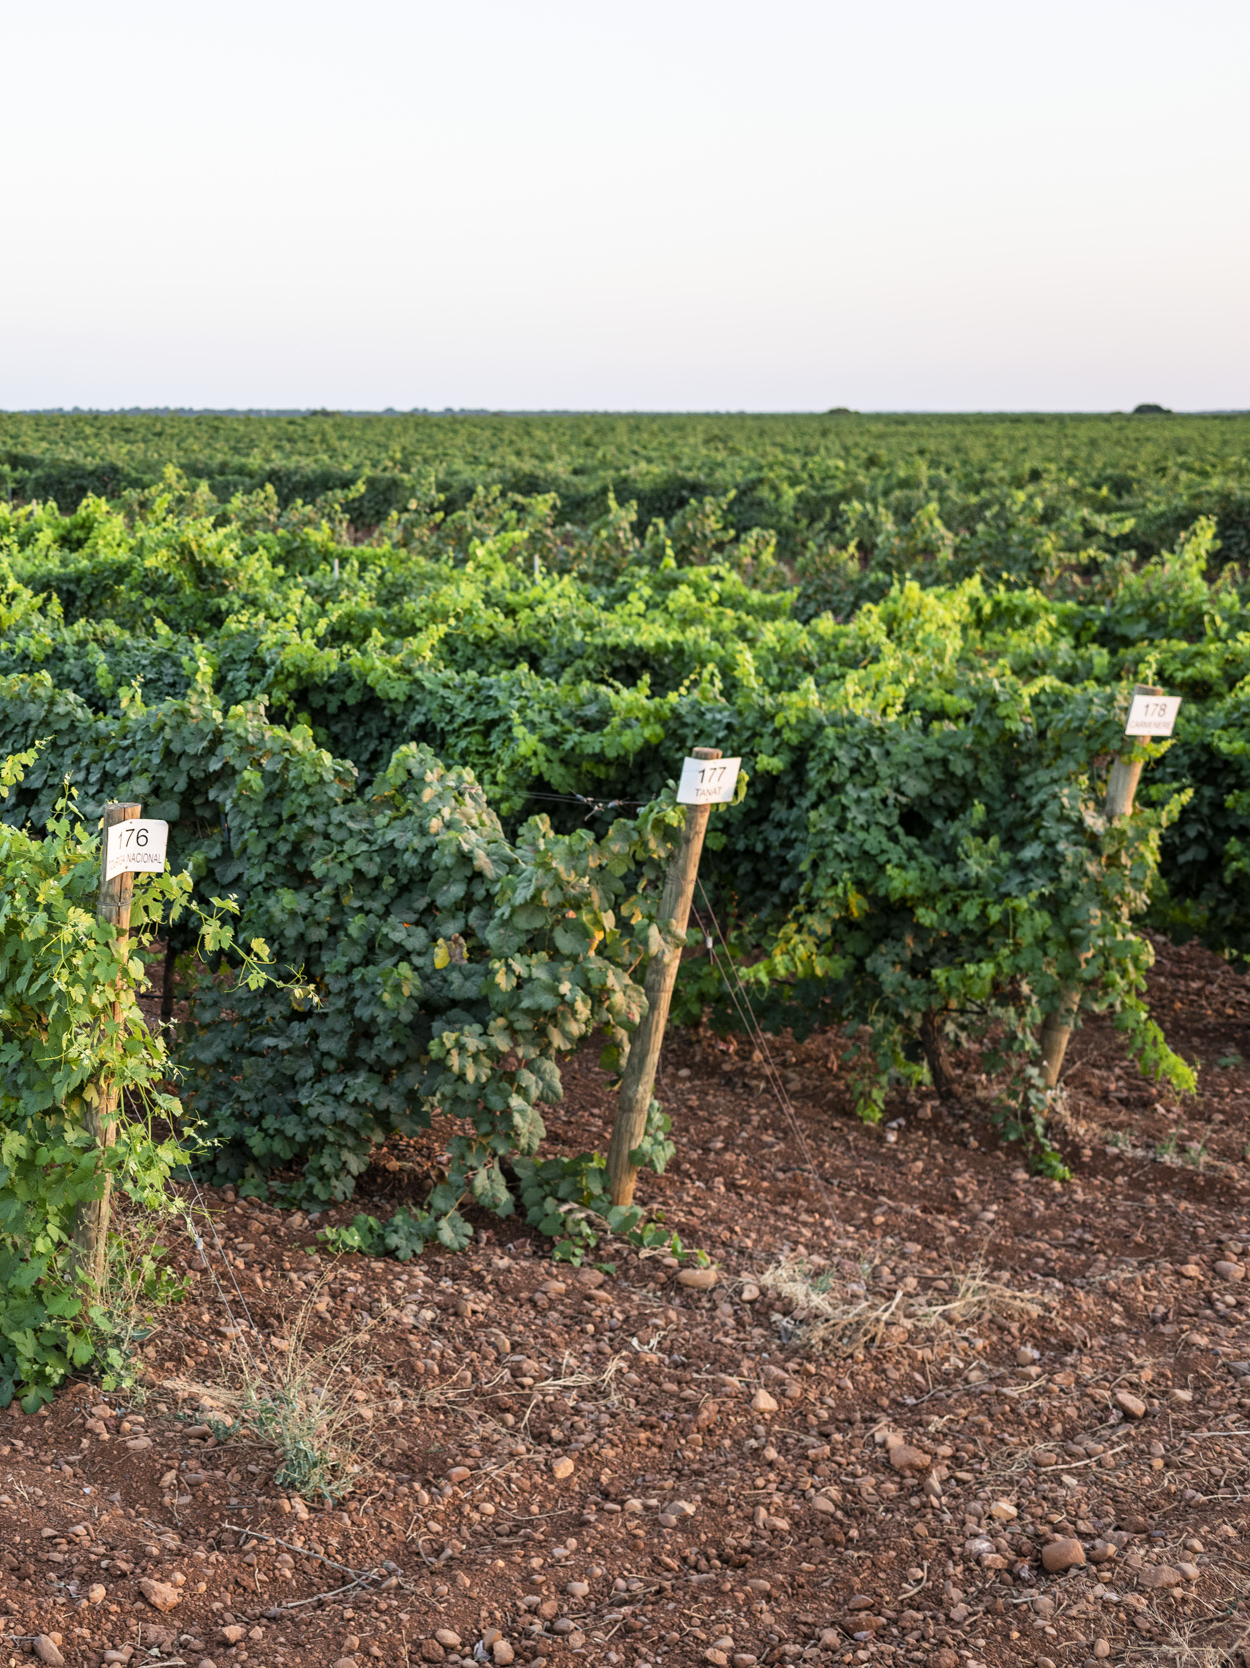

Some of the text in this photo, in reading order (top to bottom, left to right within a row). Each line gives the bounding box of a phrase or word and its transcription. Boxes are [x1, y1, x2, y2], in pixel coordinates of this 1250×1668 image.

[1144, 703, 1167, 718] 178
[698, 766, 727, 784] 177
[695, 786, 722, 797] TANAT
[118, 828, 149, 849] 176
[127, 852, 162, 864] NACIONAL
